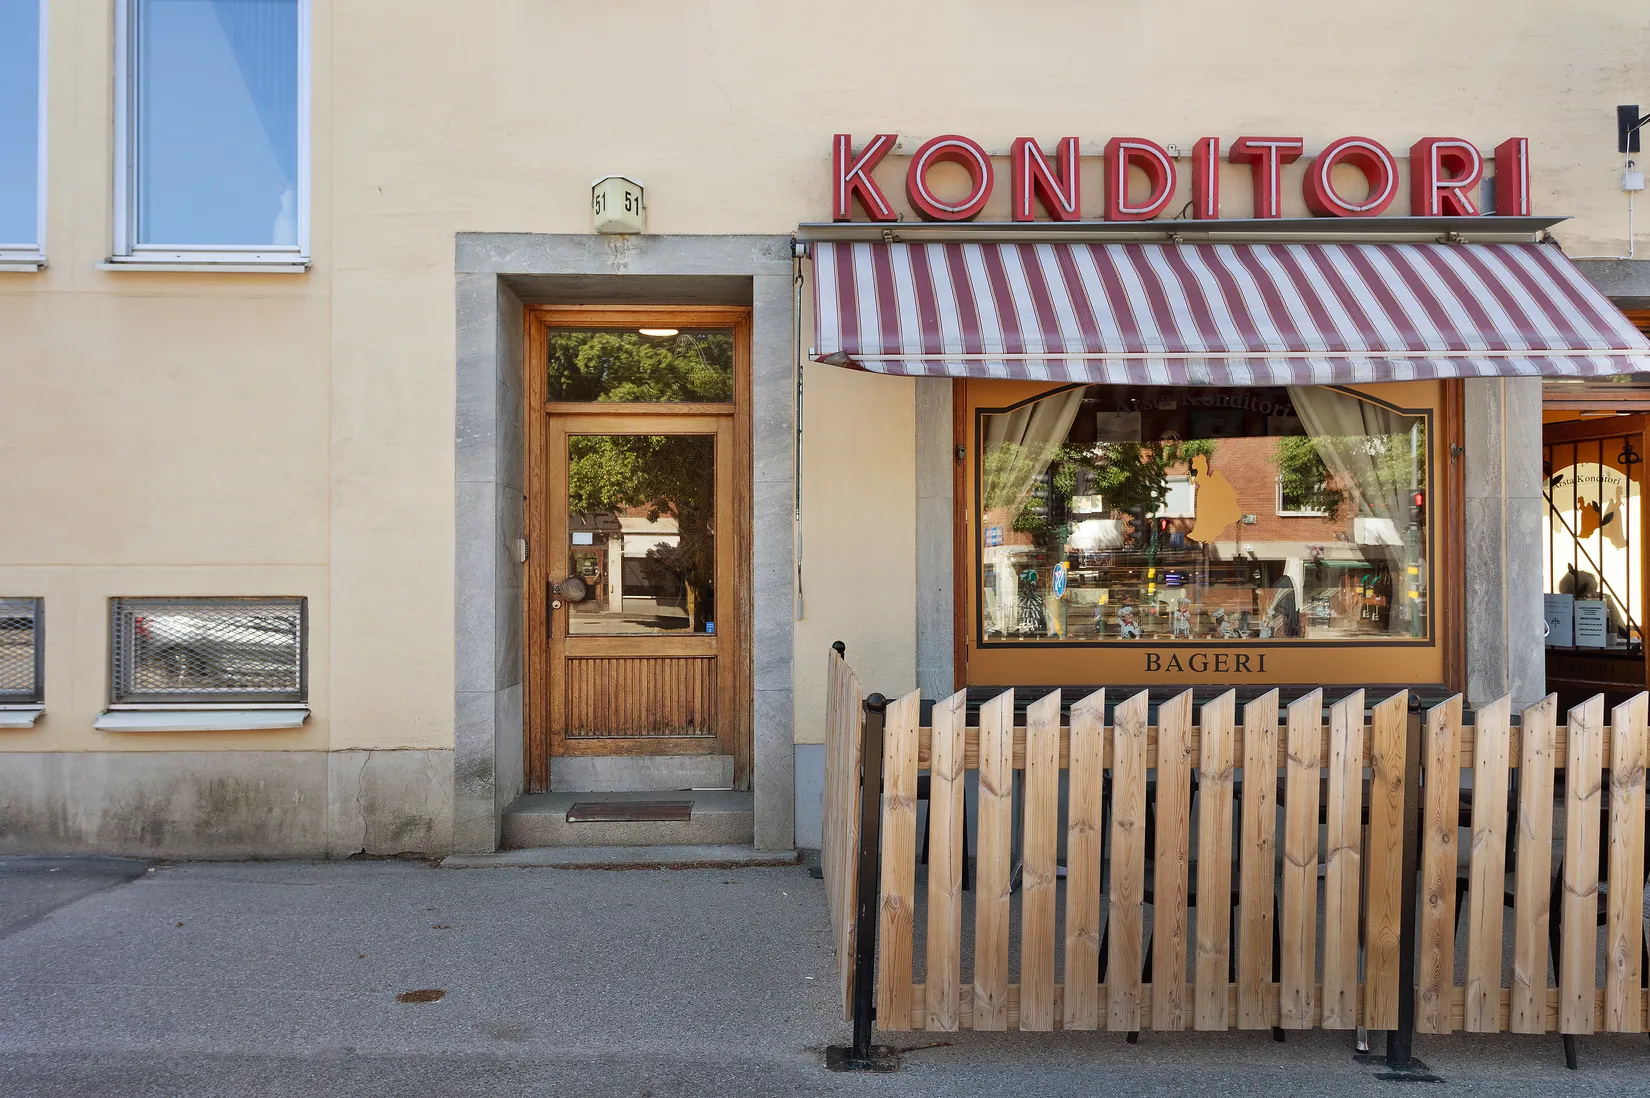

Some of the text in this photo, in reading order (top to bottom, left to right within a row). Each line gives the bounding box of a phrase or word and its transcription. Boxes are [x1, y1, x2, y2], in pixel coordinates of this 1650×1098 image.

[833, 134, 1530, 222] KONDITORI
[595, 191, 606, 215] 51
[625, 191, 639, 216] 51
[1180, 389, 1291, 420] Konditori
[1144, 652, 1267, 673] BAGERI
